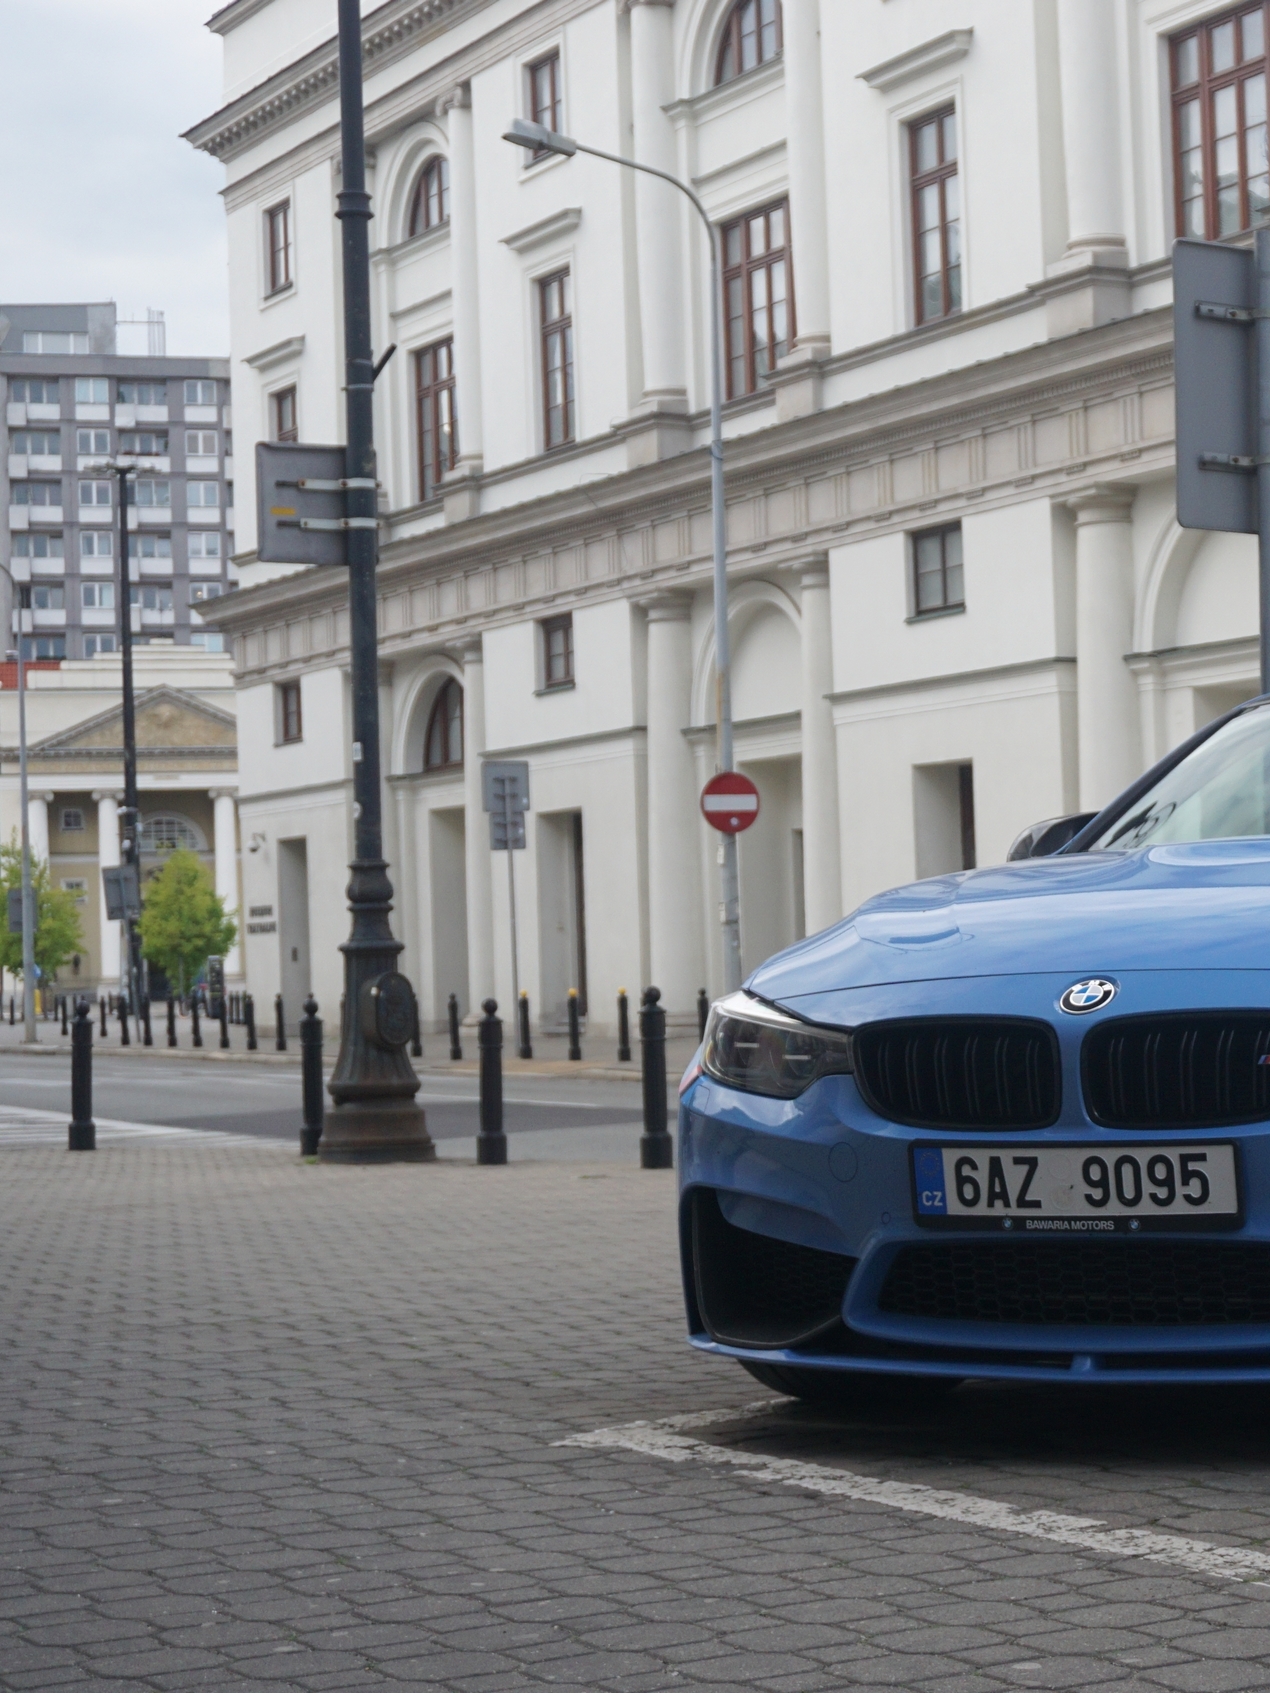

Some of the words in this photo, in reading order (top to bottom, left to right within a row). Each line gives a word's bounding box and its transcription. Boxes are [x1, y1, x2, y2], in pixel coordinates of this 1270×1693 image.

[955, 1156, 1042, 1208] 6AZ
[1082, 1153, 1210, 1206] 9095
[922, 1191, 943, 1206] CZ
[1026, 1220, 1070, 1230] BAWARIA
[1071, 1220, 1115, 1230] MOTORS
